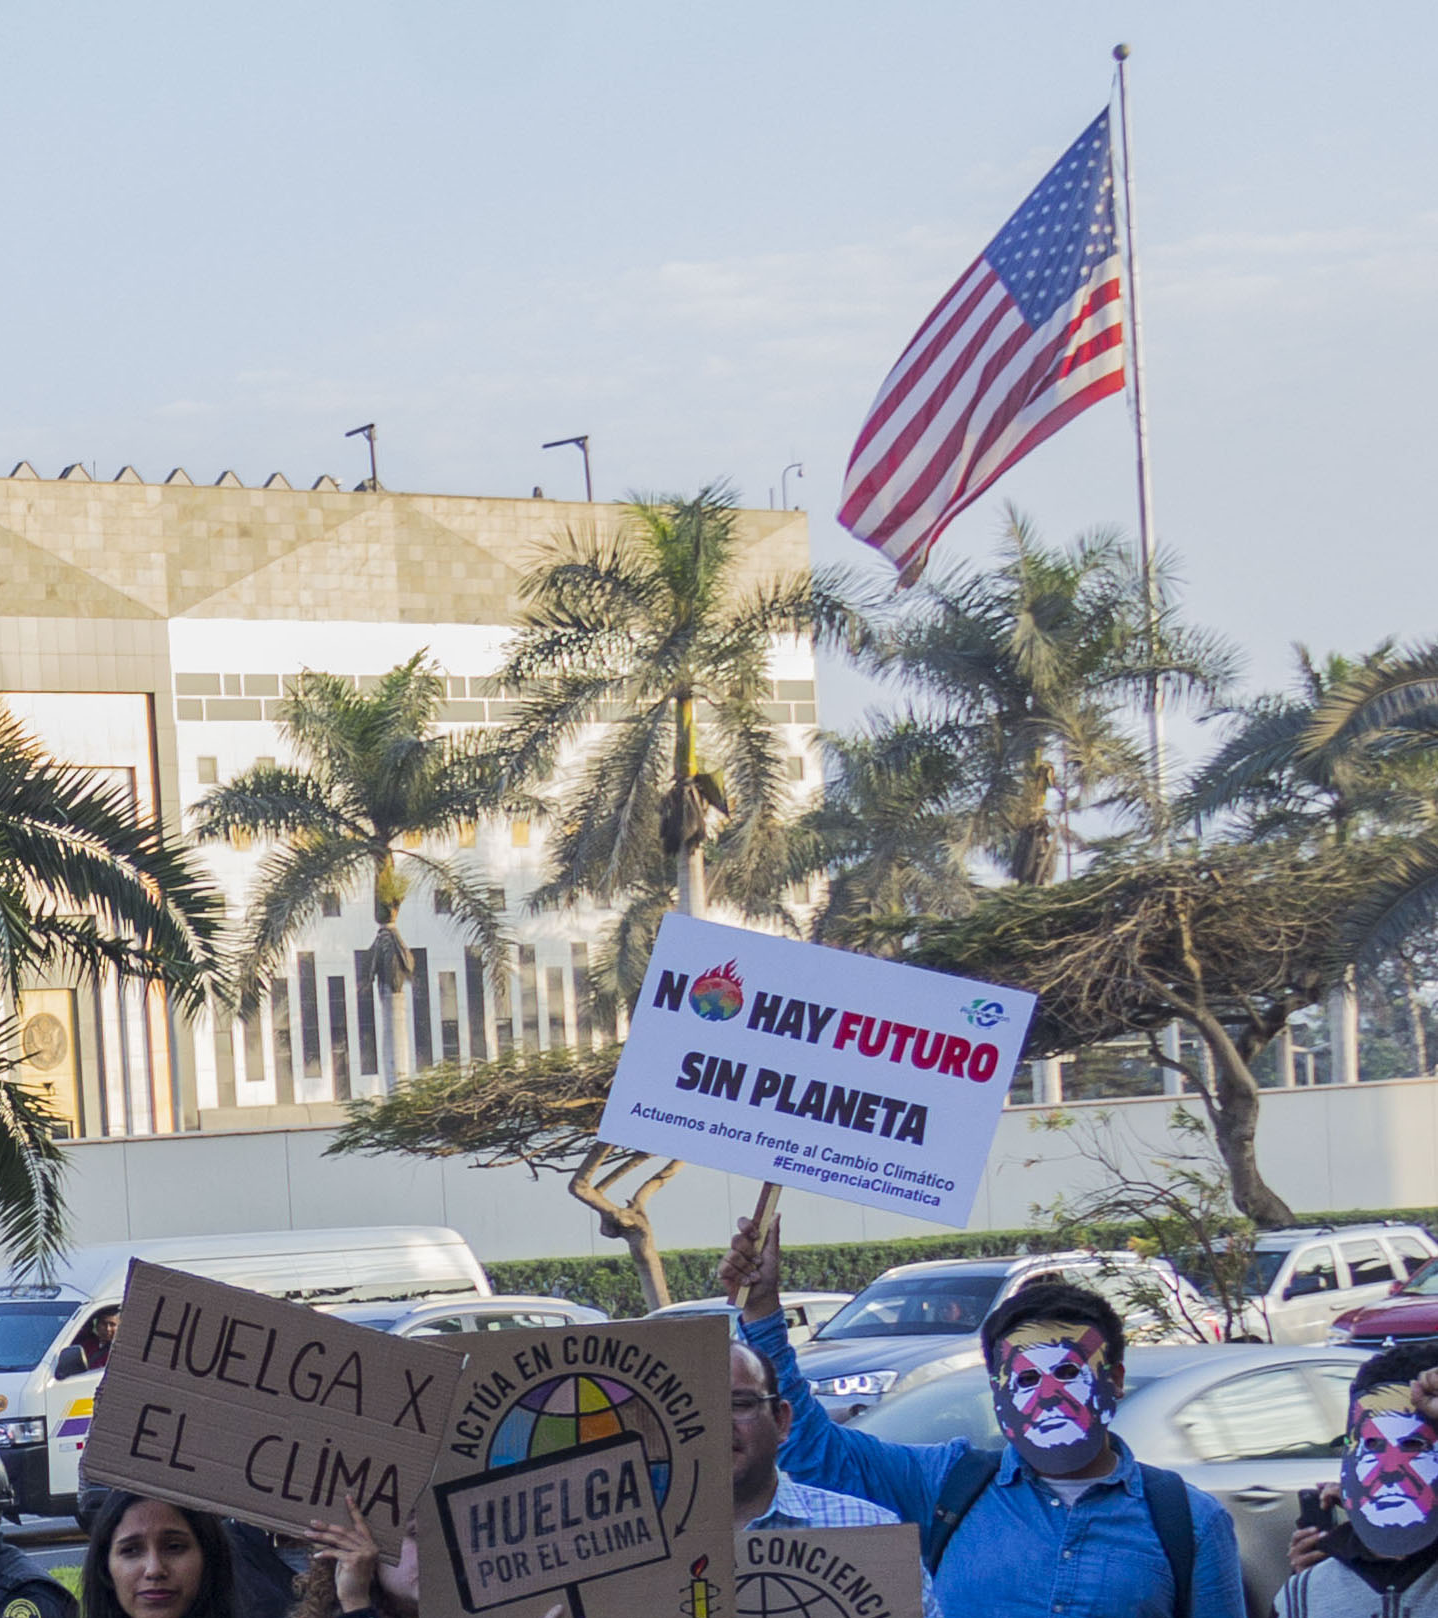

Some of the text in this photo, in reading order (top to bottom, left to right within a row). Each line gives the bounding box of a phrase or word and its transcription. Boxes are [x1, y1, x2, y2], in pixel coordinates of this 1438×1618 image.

[746, 991, 837, 1045] HAY
[833, 1011, 1000, 1083] FUTURO
[675, 1051, 928, 1146] SIN PLANETA
[630, 1102, 955, 1192] Actuemos ahora frente al Cambio Climático
[773, 1155, 941, 1207] #EmergenciaClimatica
[142, 1296, 434, 1434] HUELGA X
[450, 1335, 705, 1459] ACTÚA EN CONCIENCIA
[130, 1404, 196, 1472] EL
[470, 1460, 642, 1553] HUELGA
[477, 1516, 652, 1589] POR EL CLIMA
